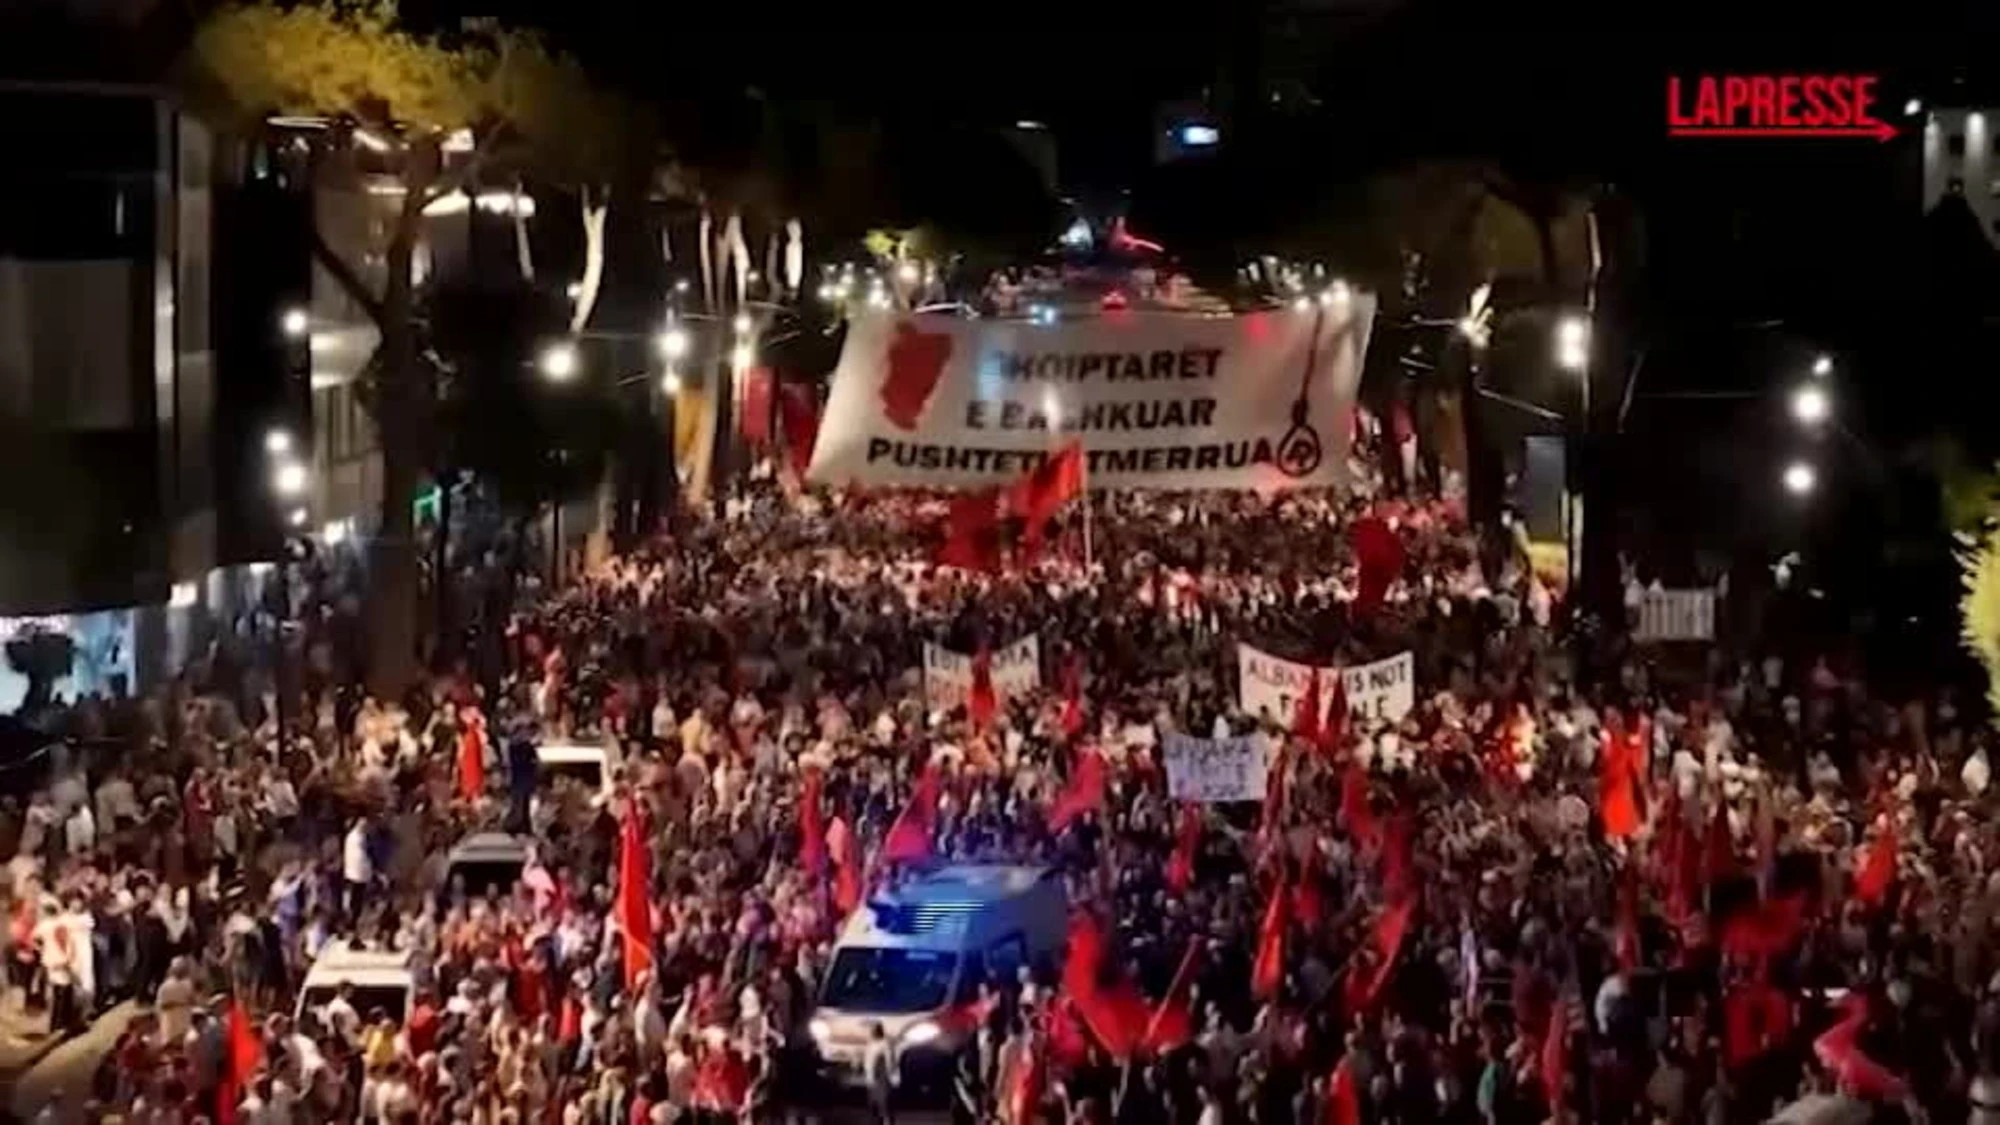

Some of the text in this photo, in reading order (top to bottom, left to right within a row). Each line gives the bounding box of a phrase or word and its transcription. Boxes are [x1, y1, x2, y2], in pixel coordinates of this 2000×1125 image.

[992, 347, 1223, 382] HQIPTARET
[966, 399, 1217, 430] E BAHKUAR
[1369, 661, 1406, 690] NOT
